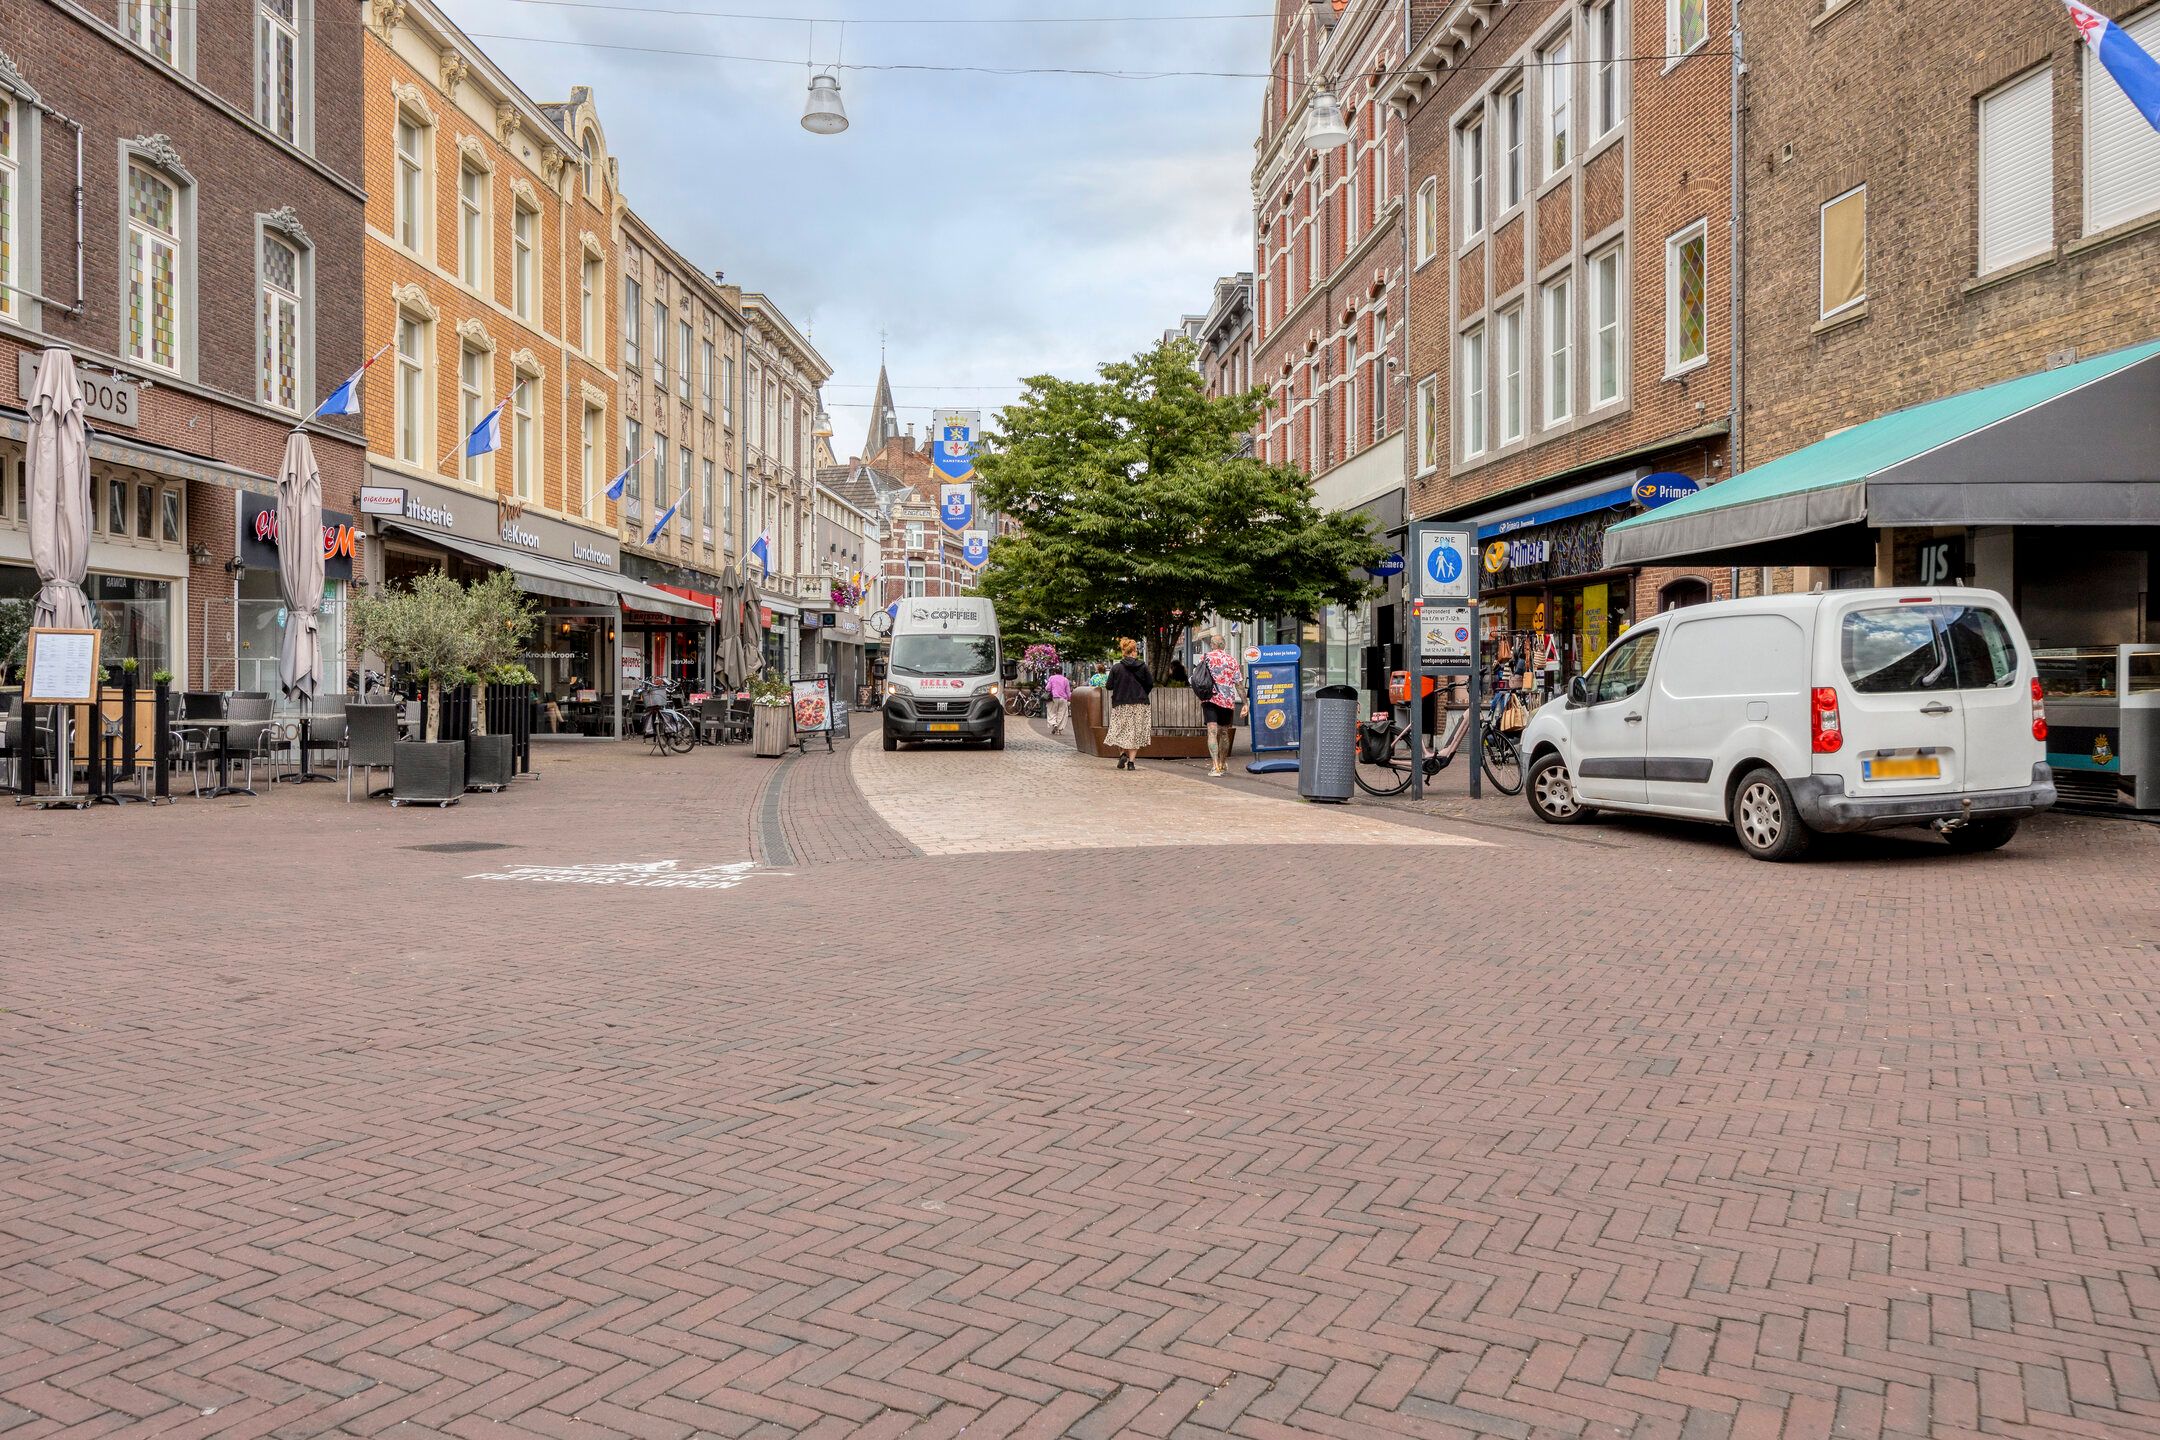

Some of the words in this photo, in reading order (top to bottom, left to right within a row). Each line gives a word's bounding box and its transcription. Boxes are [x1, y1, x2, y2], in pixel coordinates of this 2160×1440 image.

[1659, 485, 1698, 498] Primera
[406, 498, 454, 528] atisserie
[502, 521, 540, 549] deKroon
[574, 541, 613, 566] Lunchroom
[1510, 540, 1545, 568] Primera
[1378, 560, 1404, 569] Primera
[1921, 544, 1950, 585] IJS
[930, 611, 978, 621] COFFEE
[936, 702, 948, 711] FIAT
[461, 872, 627, 884] FIETSERS
[622, 878, 742, 889] LOPEN
[657, 873, 754, 881] OPEN
